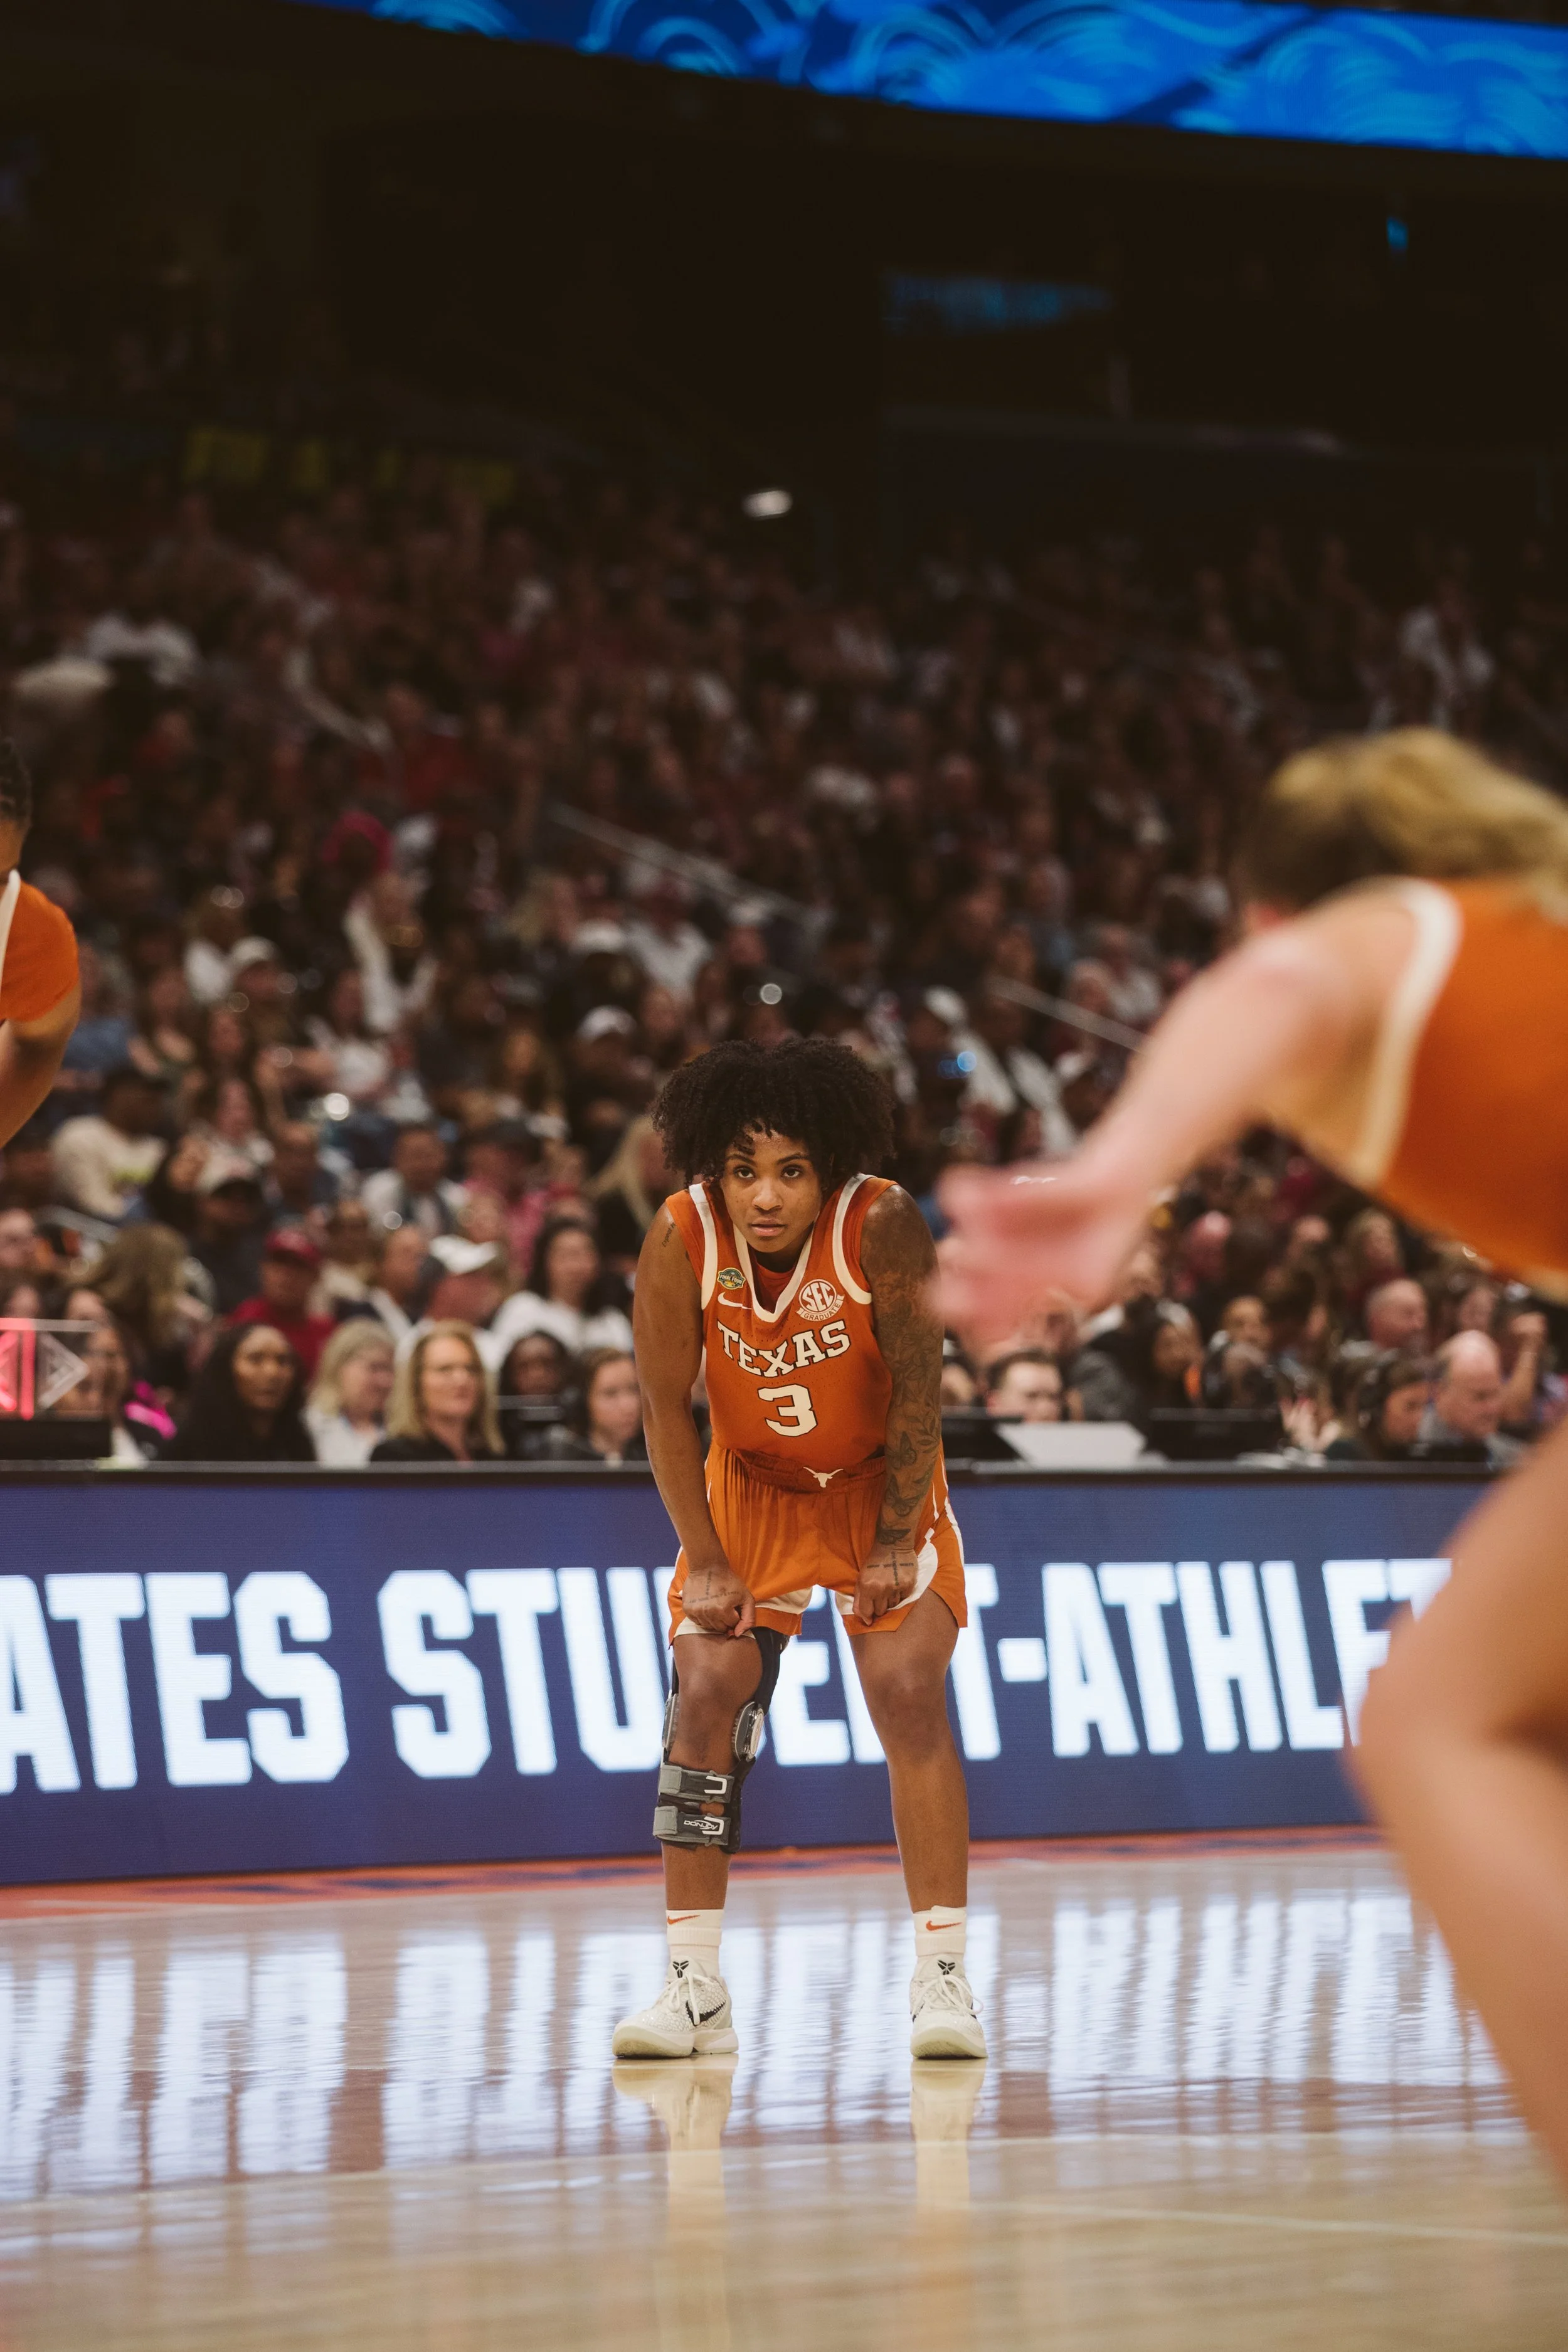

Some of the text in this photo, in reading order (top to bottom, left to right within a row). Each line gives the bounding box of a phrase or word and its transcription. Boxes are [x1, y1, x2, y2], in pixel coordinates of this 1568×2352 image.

[802, 1282, 834, 1311] SEC
[803, 1303, 840, 1321] GRADUATE
[717, 1320, 850, 1377] TEXAS
[758, 1384, 818, 1437] 3
[683, 1820, 718, 1830] DONJOY
